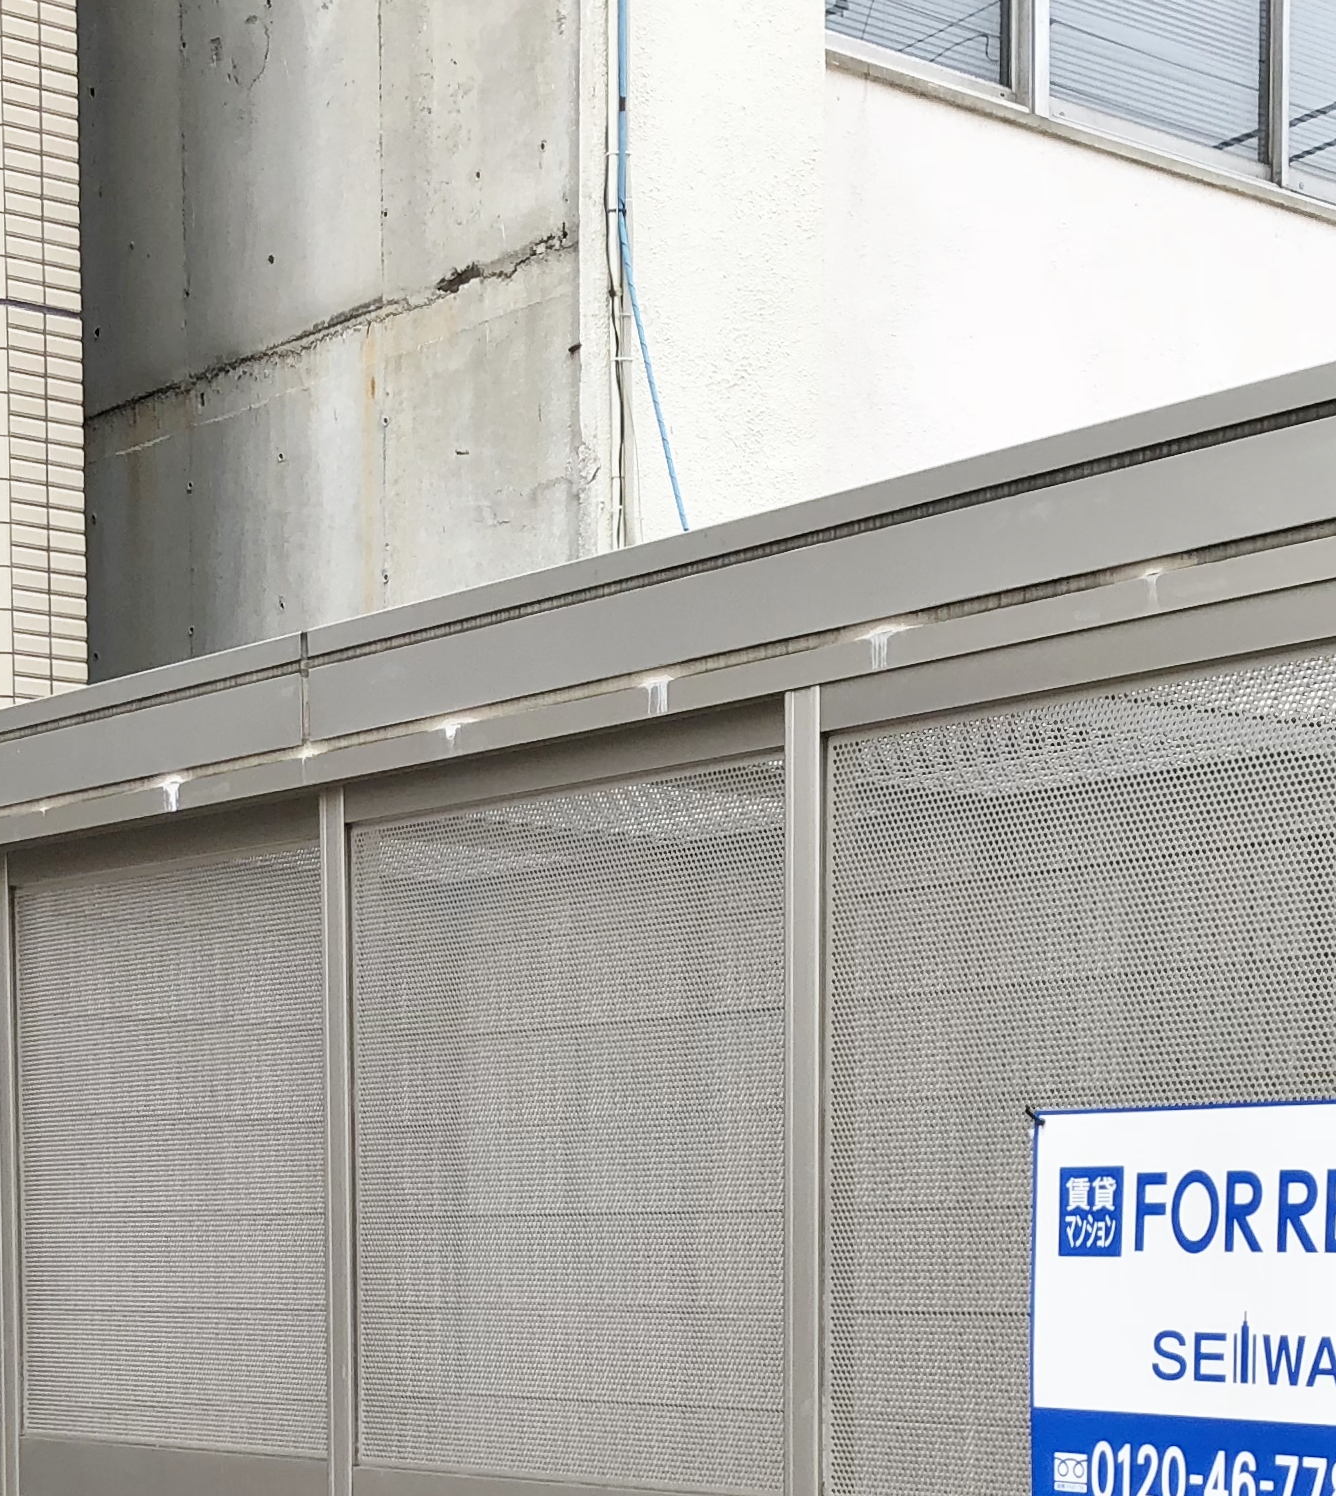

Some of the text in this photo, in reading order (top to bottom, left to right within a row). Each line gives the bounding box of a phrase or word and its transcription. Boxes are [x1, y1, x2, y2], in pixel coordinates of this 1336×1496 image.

[1066, 1176, 1117, 1212] 賃貸
[1133, 1169, 1263, 1254] FOR
[1065, 1213, 1116, 1248] マンション
